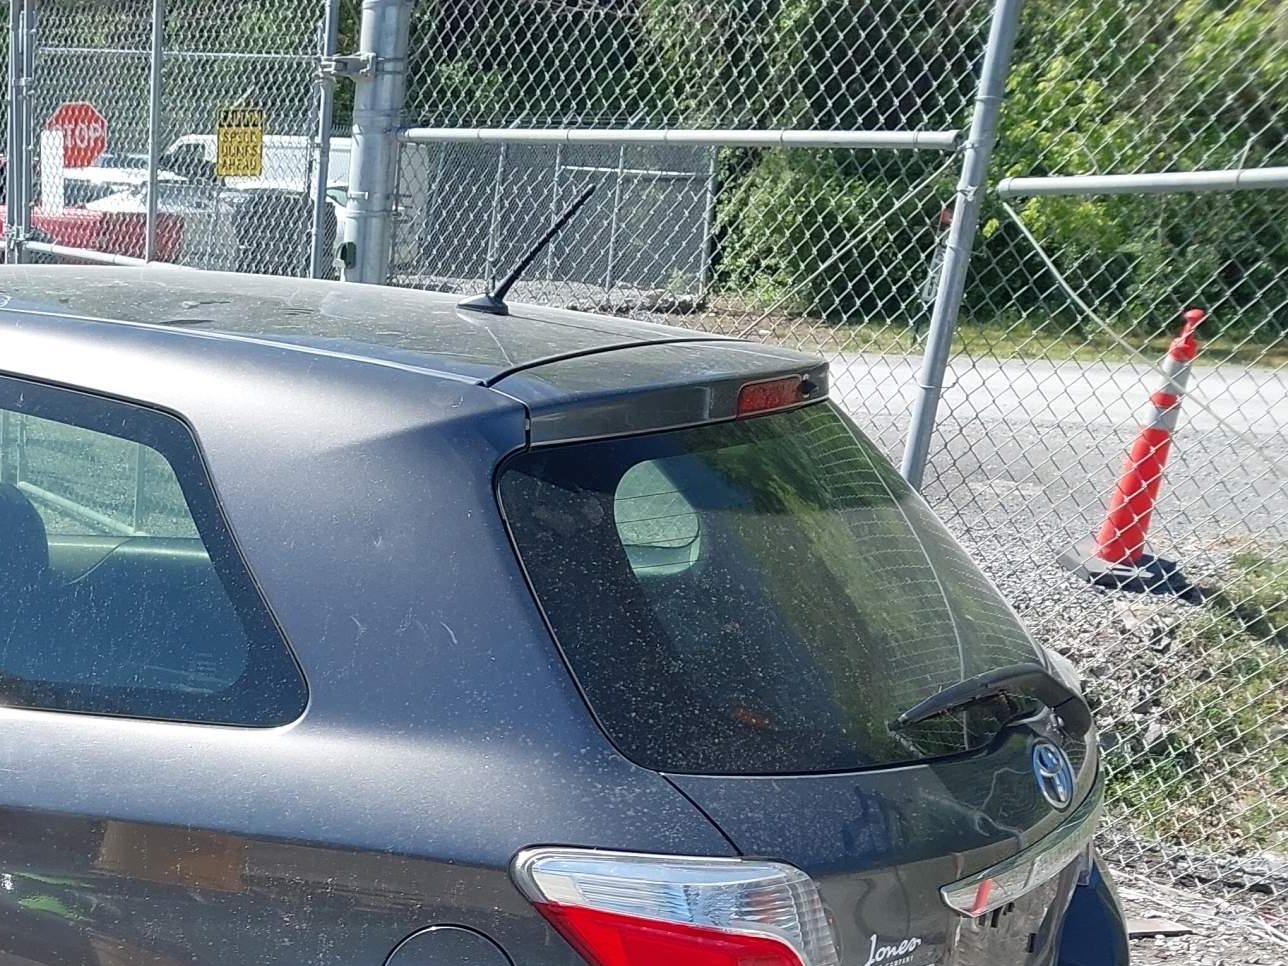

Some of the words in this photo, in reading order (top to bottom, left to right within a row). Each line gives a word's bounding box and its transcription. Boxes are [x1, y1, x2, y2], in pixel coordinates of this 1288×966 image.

[219, 110, 263, 127] CAUTION
[53, 122, 102, 149] TOP
[222, 158, 258, 171] AHEAD
